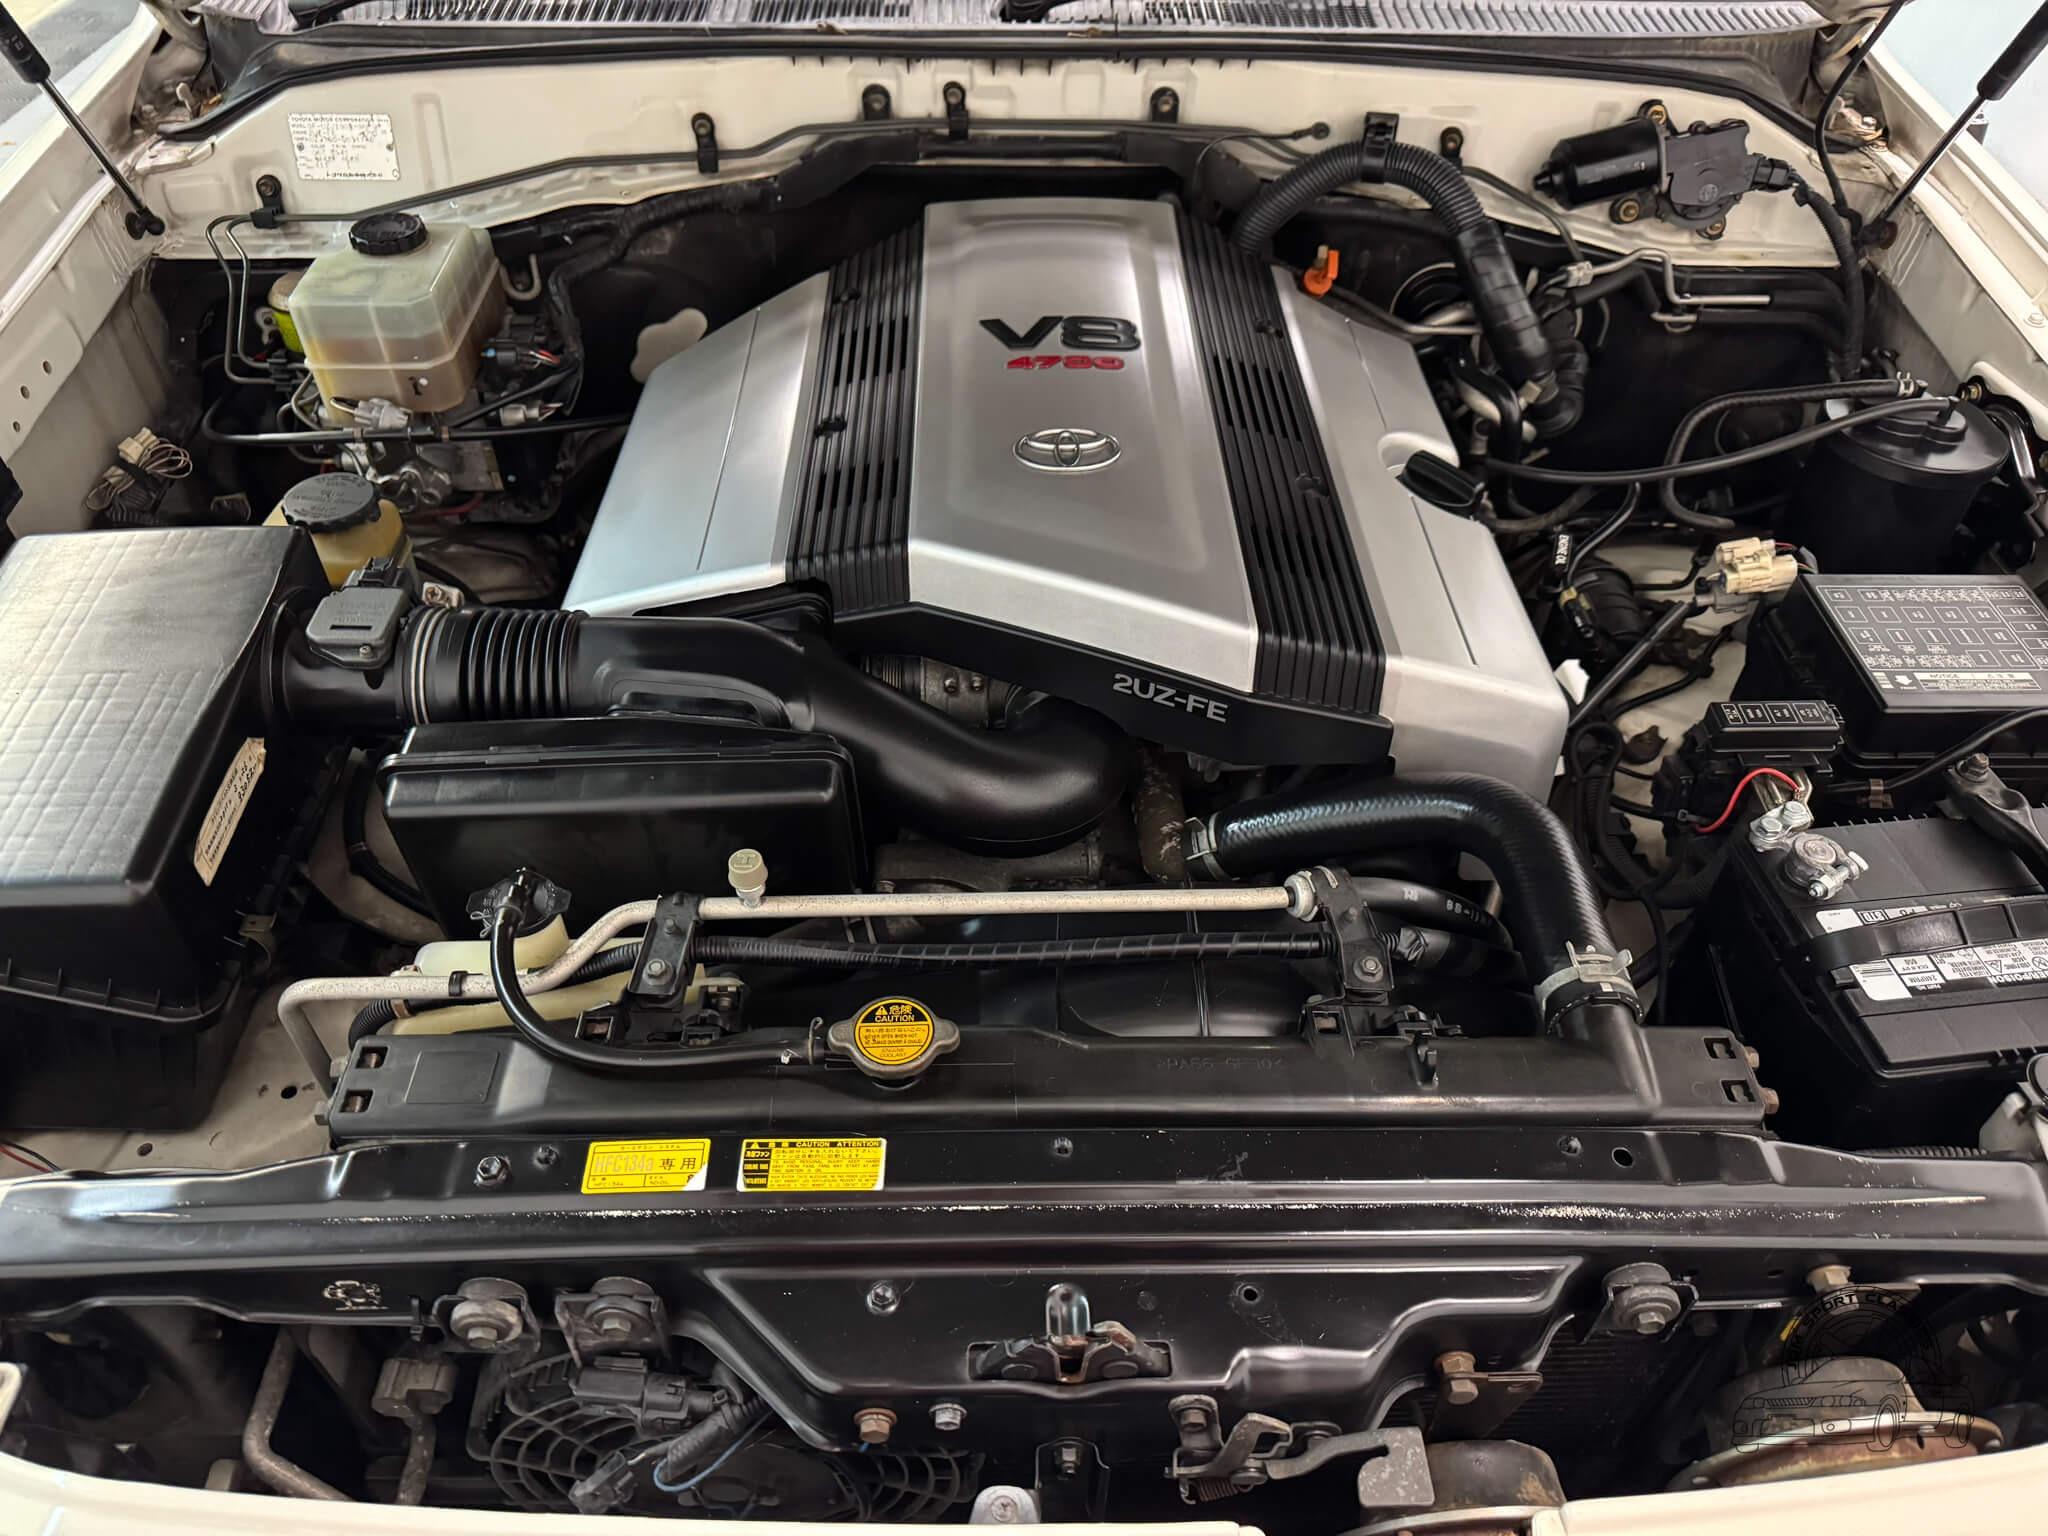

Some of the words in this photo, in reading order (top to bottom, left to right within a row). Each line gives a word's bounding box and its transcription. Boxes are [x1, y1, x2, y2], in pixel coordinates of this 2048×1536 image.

[979, 315, 1141, 351] V8
[1007, 355, 1125, 370] 4700
[1112, 672, 1229, 723] 2UZ-FE
[874, 1014, 915, 1023] CAUTION
[593, 1152, 654, 1174] HFC134a
[659, 1157, 697, 1171] 専用
